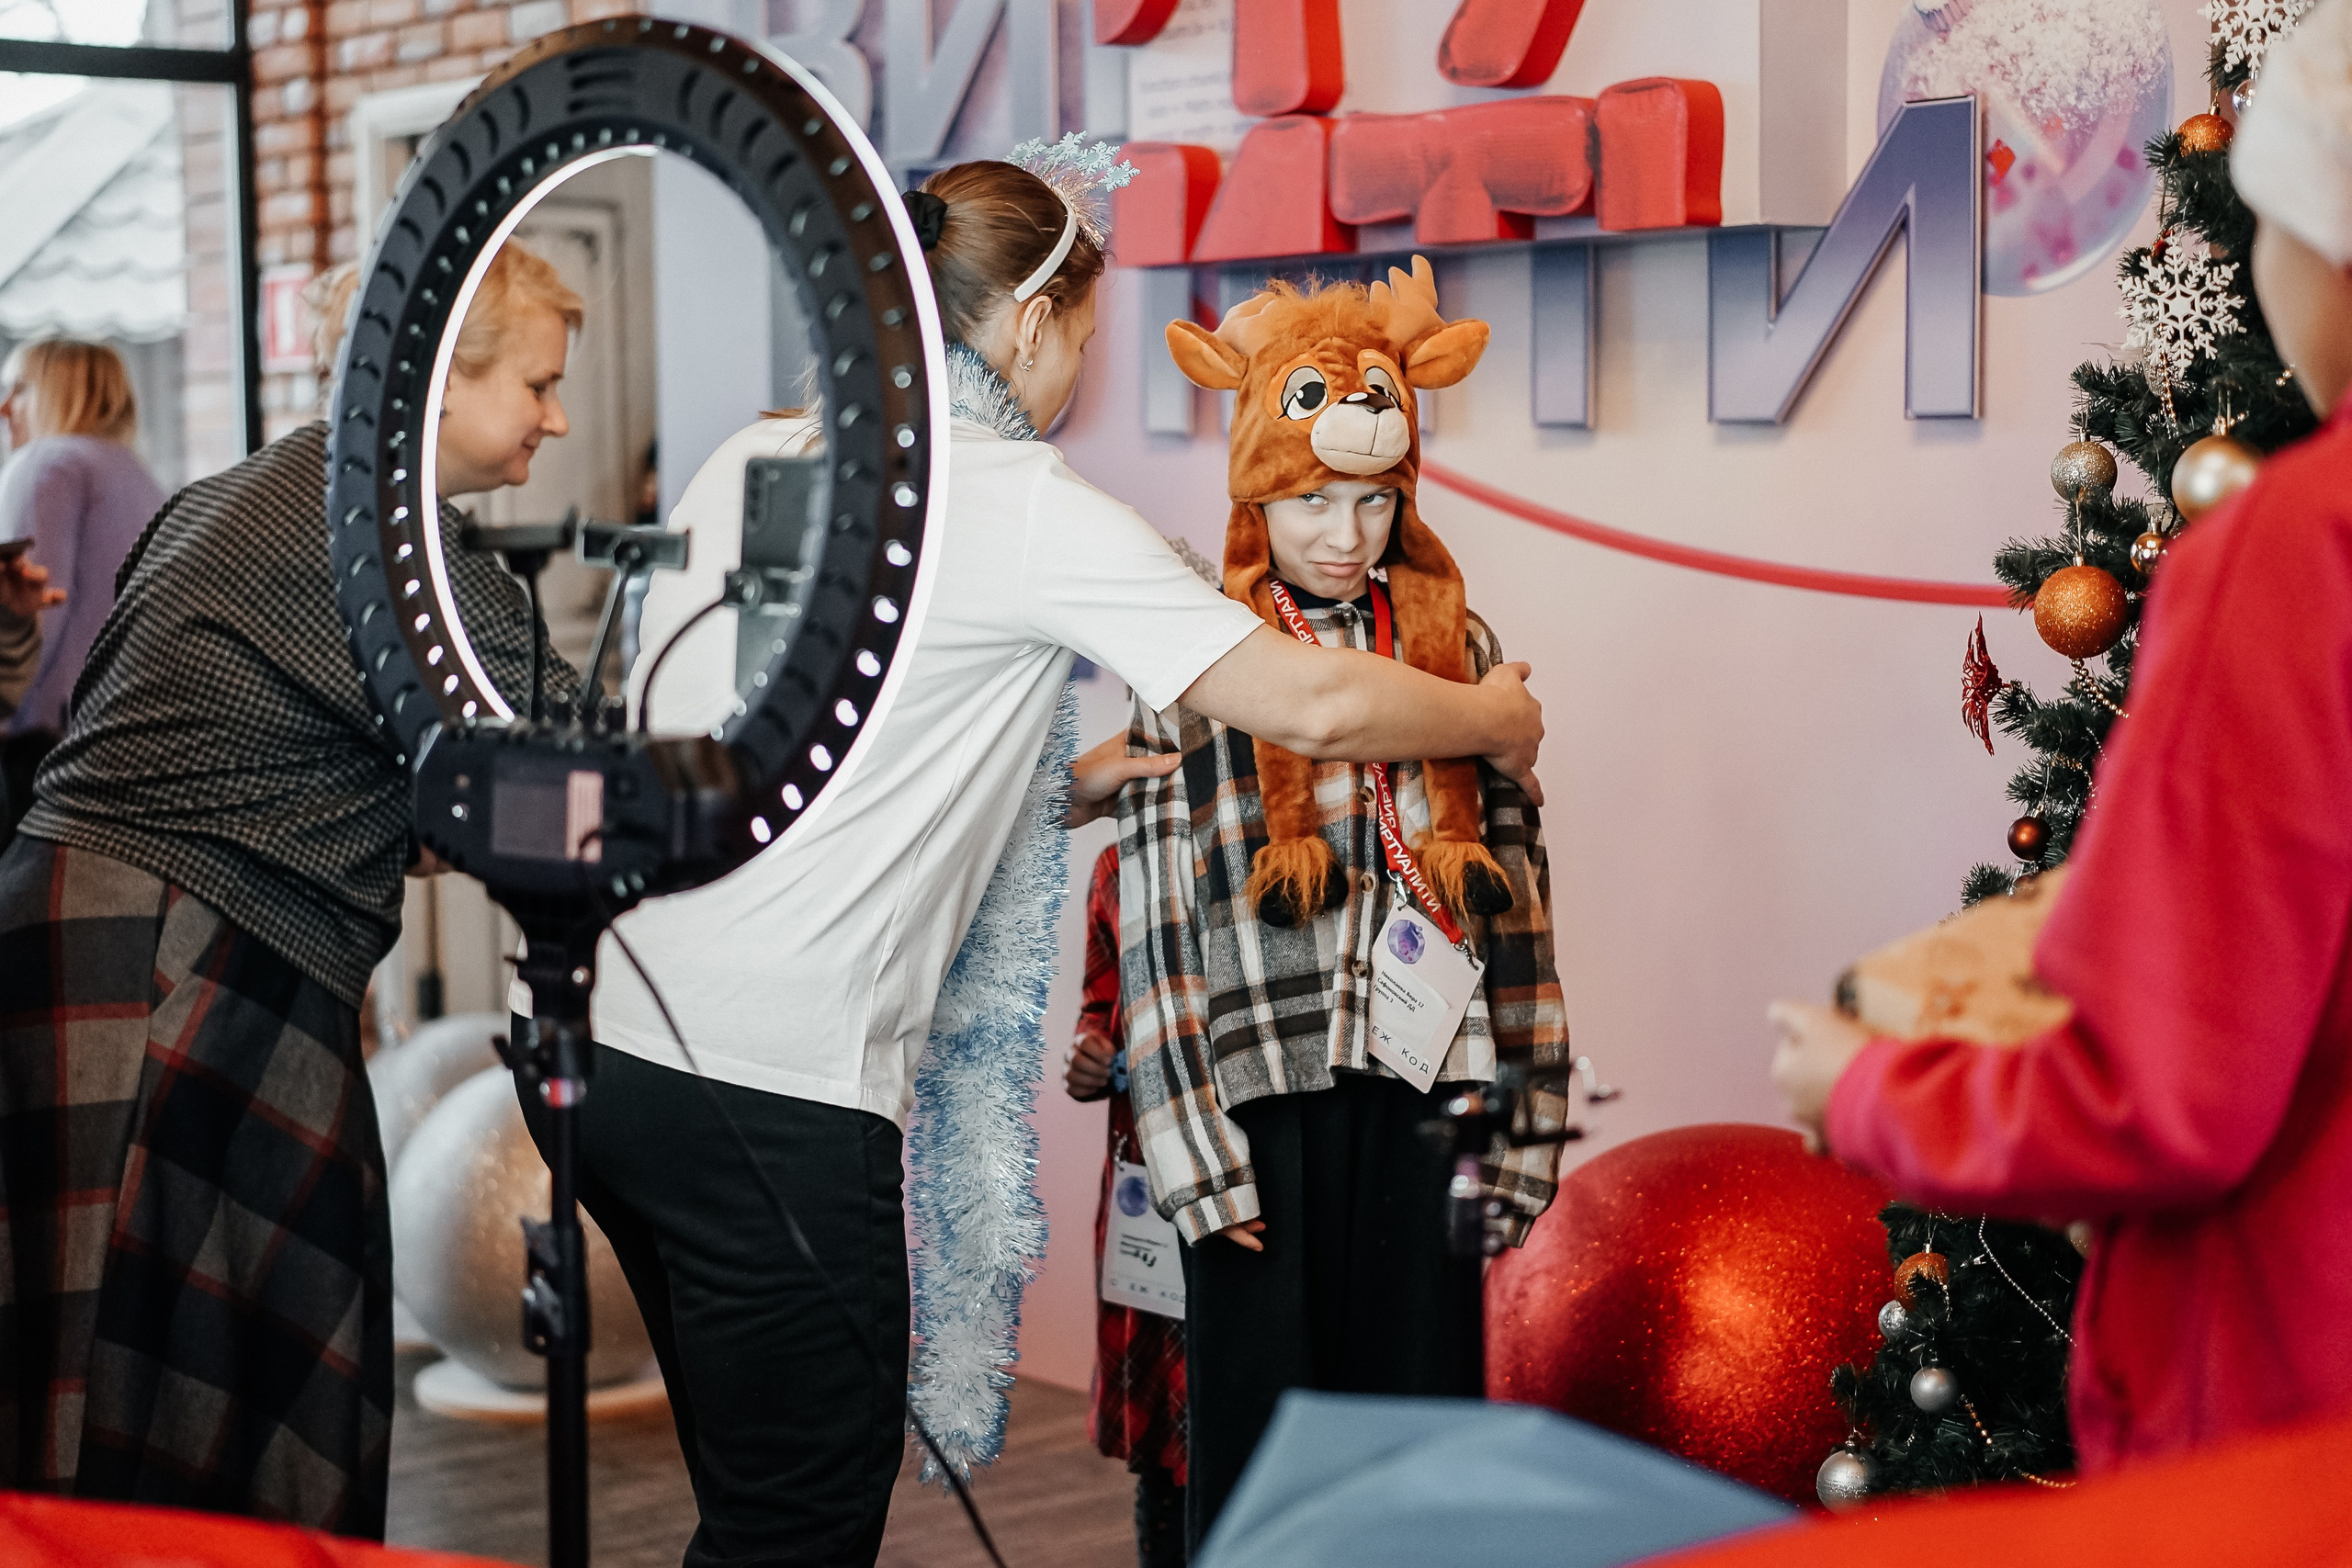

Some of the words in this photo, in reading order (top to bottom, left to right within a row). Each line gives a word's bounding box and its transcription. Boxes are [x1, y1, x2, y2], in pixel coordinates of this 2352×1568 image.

[1378, 806, 1442, 913] ИРТУАЛИТИ
[1374, 984, 1390, 1000] Группа
[1377, 977, 1408, 1005] Сафоновский
[1407, 1003, 1416, 1012] ДД
[1406, 991, 1418, 1003] Вера
[1401, 1047, 1429, 1075] КОД
